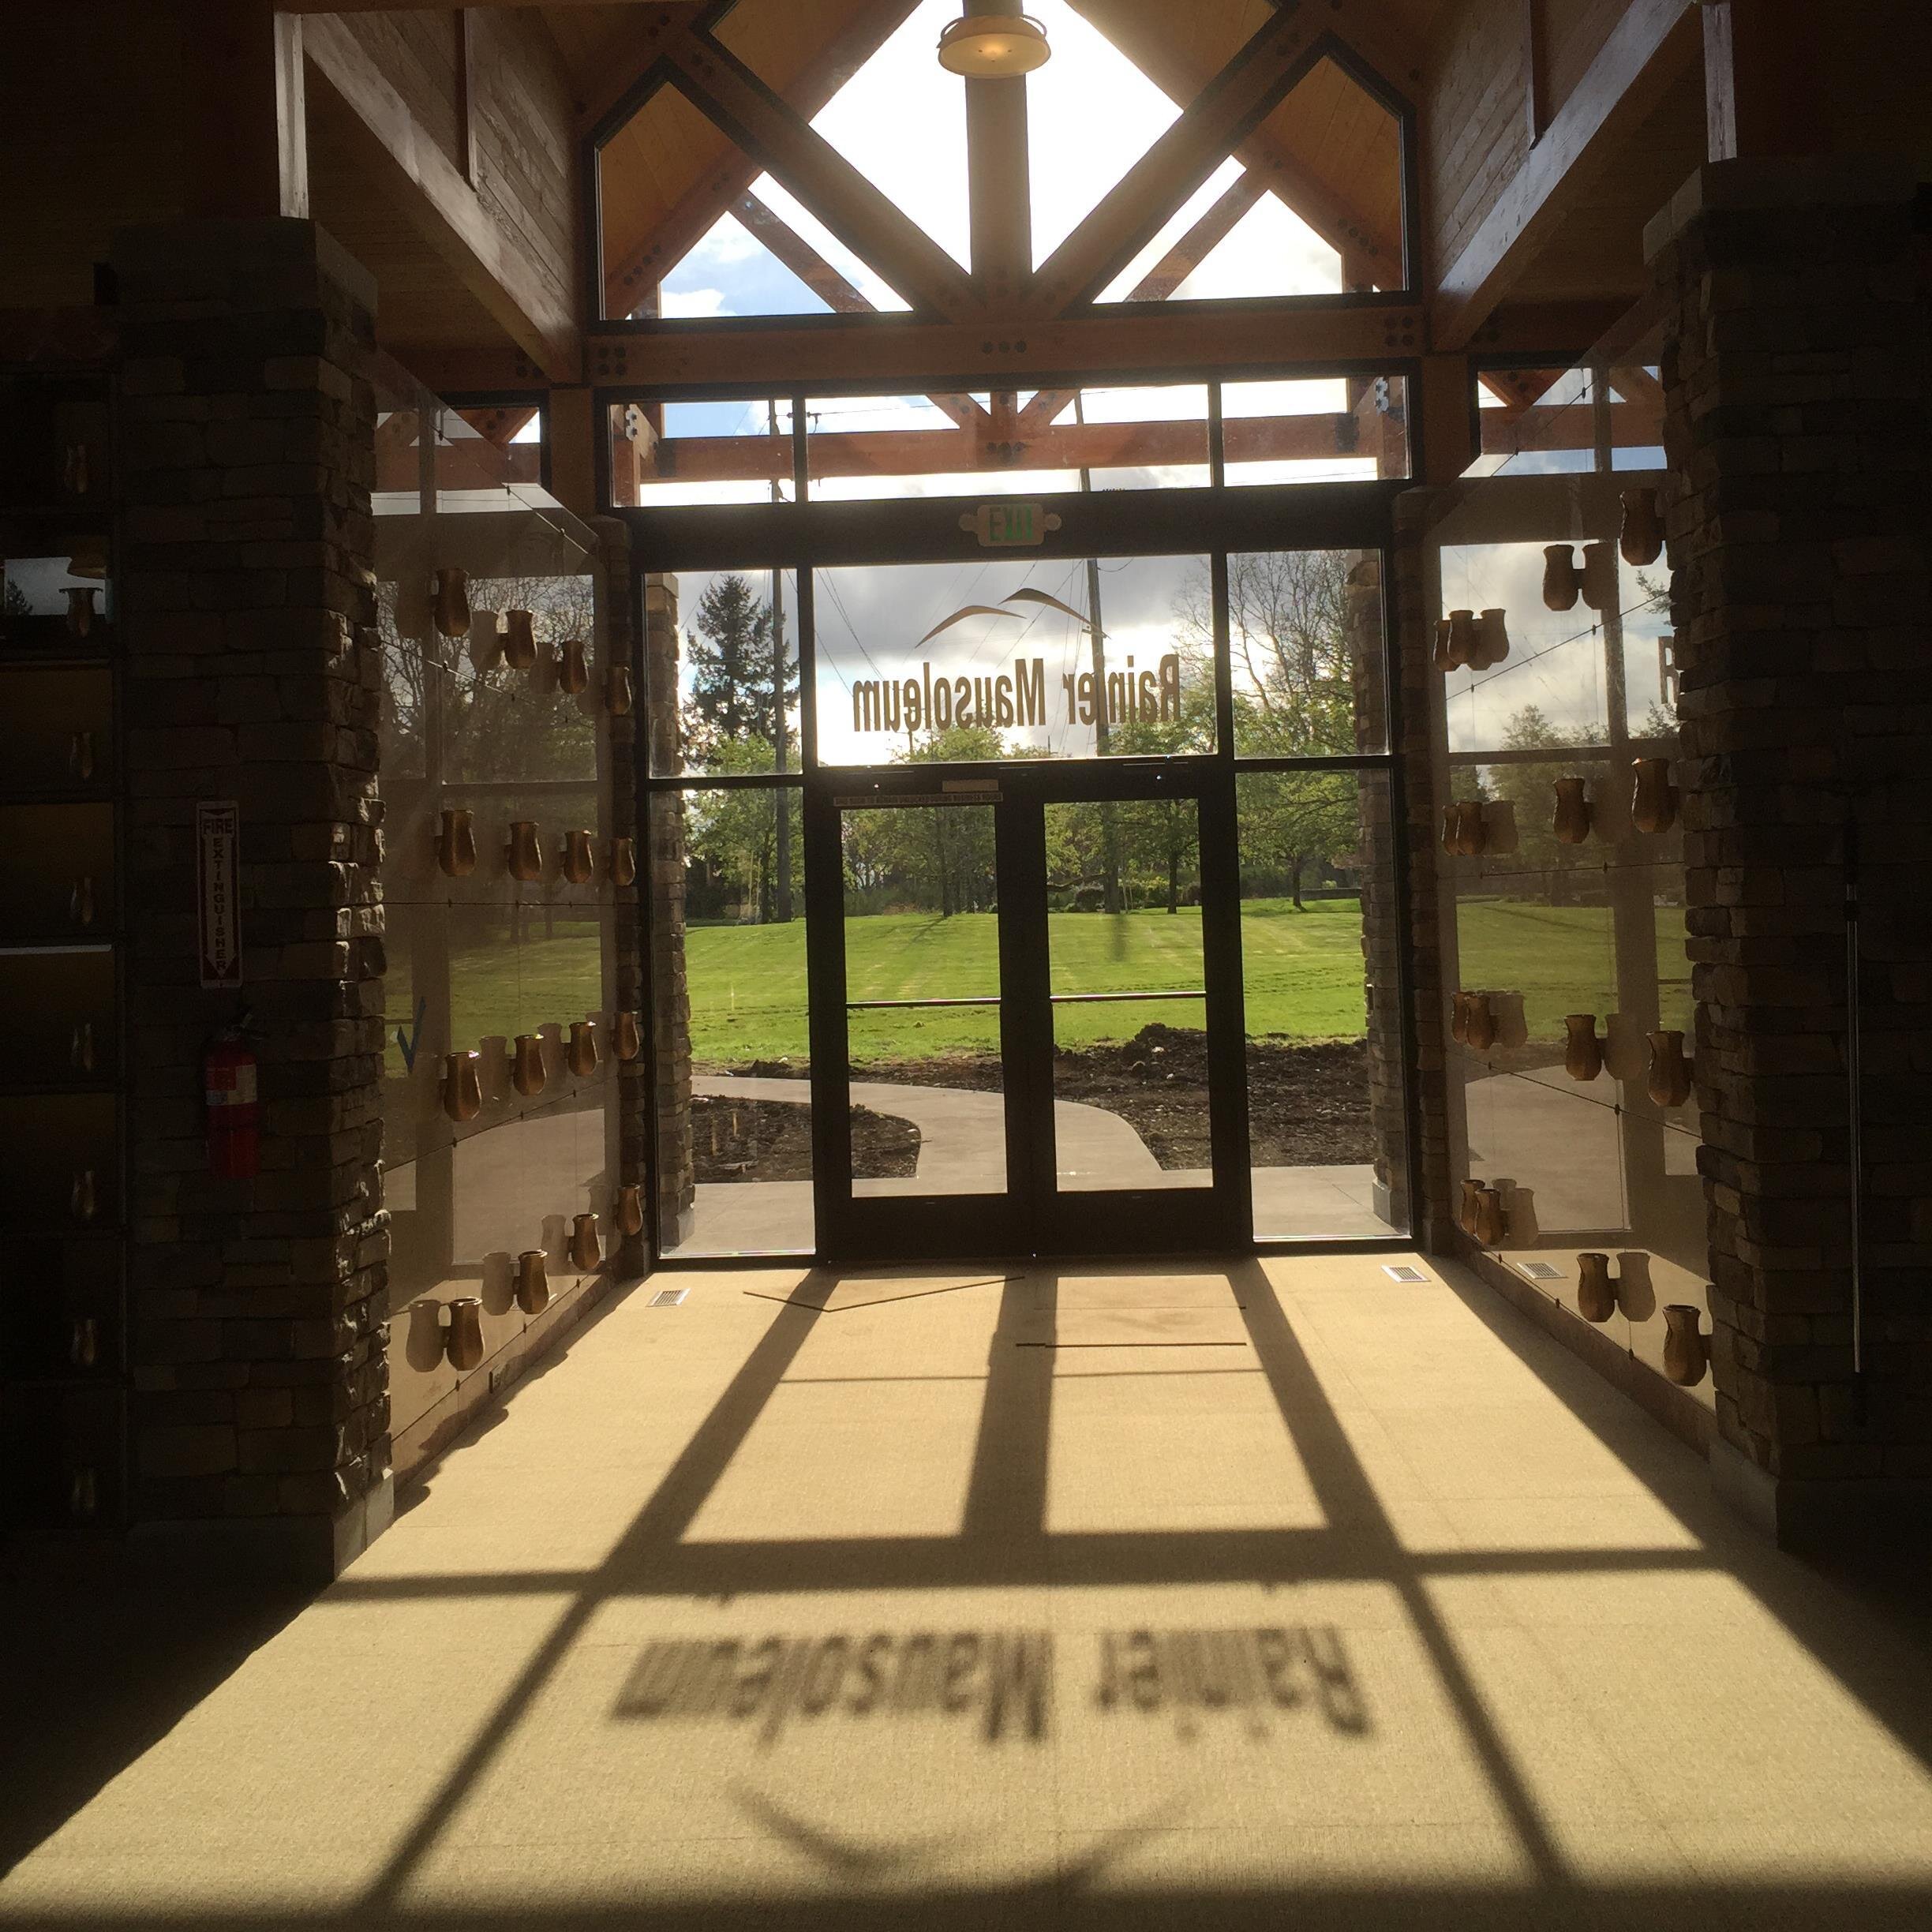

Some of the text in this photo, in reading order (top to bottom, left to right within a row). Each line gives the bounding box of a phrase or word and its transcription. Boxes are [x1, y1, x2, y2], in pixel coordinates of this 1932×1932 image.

[989, 506, 1033, 541] EXIT
[201, 818, 234, 834] FIRE
[213, 837, 227, 971] EXTINGUISHER
